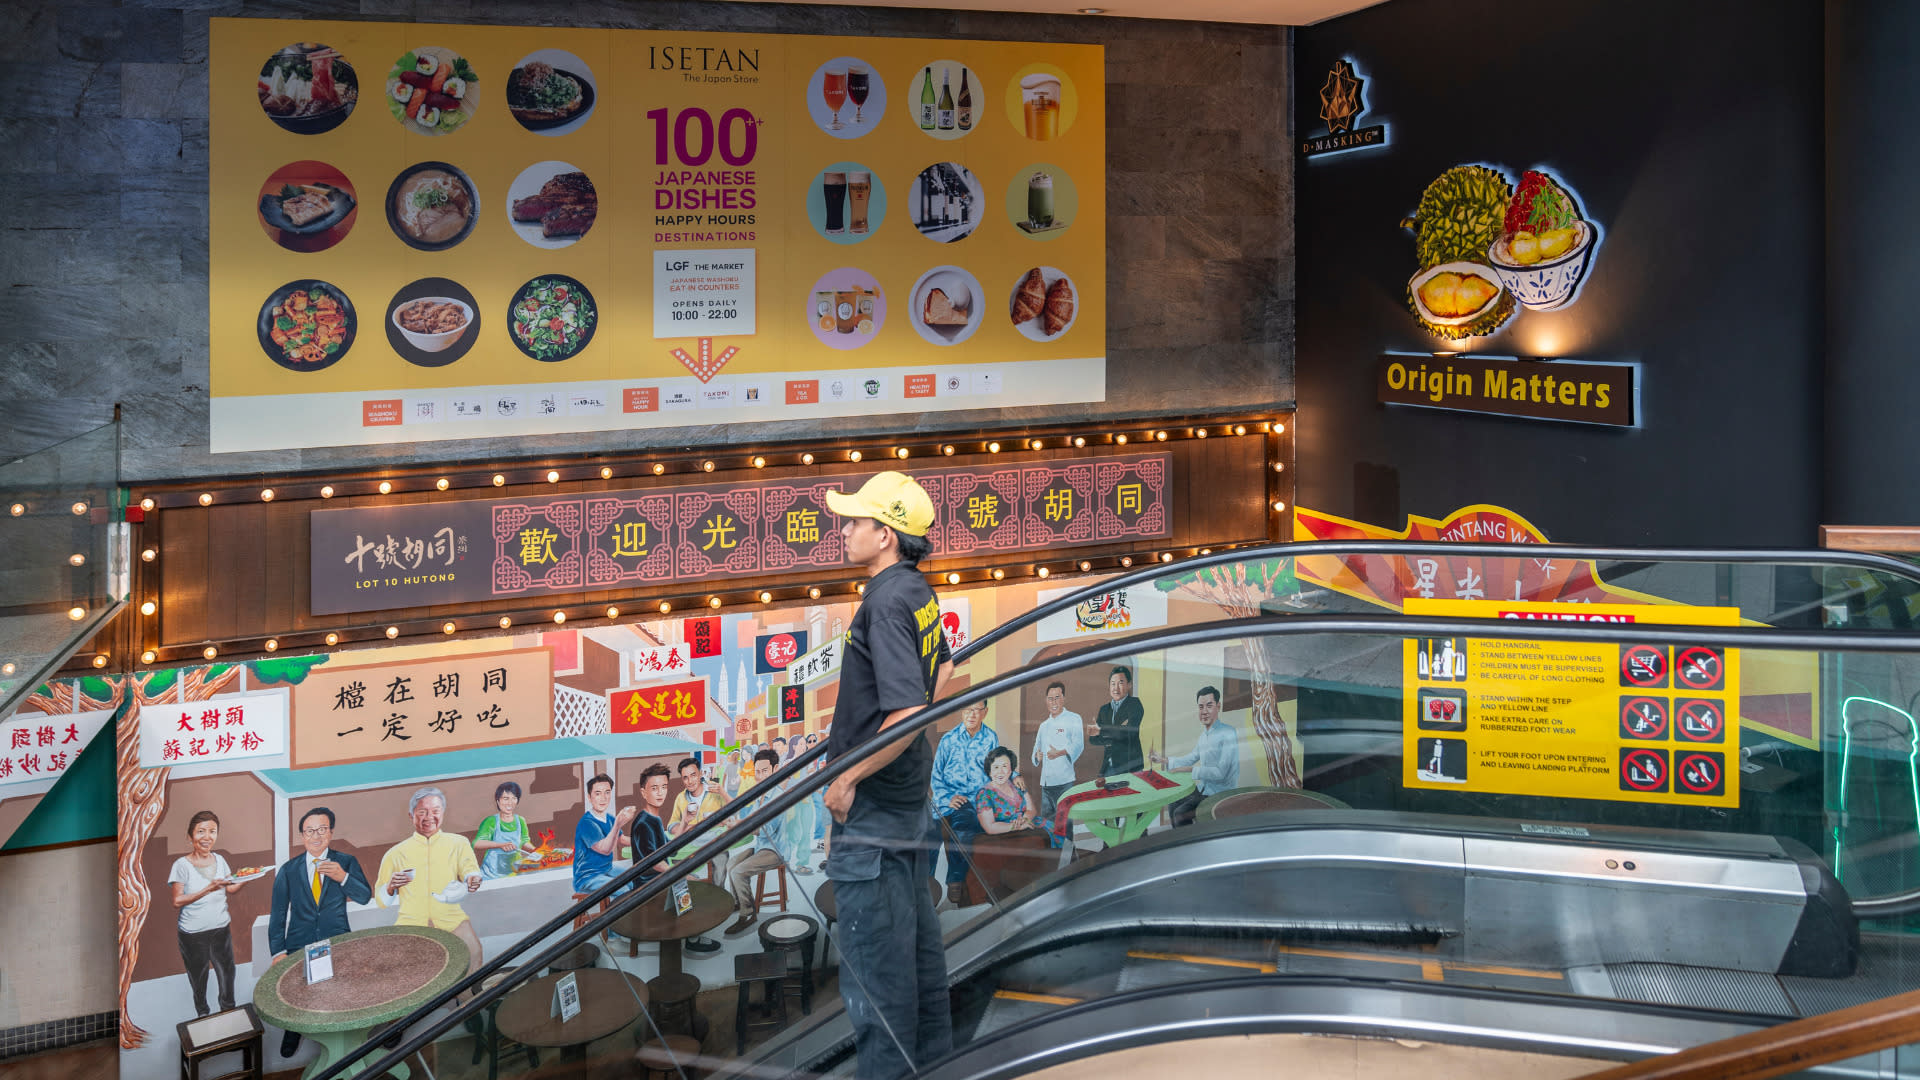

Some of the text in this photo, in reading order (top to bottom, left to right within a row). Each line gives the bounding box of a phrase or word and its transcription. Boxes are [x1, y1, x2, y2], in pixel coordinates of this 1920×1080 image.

[648, 46, 760, 71] ISETAN
[684, 73, 758, 84] The Japan Store
[655, 171, 756, 185] JAPANESE
[655, 188, 756, 210] DISHES
[655, 214, 755, 226] HAPPY HOURS
[655, 231, 756, 243] DESTINATIONS
[665, 261, 689, 271] LGF
[673, 300, 704, 308] OPENS
[672, 311, 698, 321] 10:00
[708, 309, 737, 320] 22:00
[1387, 362, 1611, 408] Origin Matters
[356, 573, 455, 589] LOT 10 HUTONG
[1503, 642, 1541, 650] HANDRAIL
[1480, 662, 1518, 670] CHILDREN
[1555, 665, 1604, 673] SUPERVISED
[1541, 674, 1563, 682] LONG
[332, 667, 508, 711] 檔在胡同
[1507, 695, 1533, 703] WITHIN
[177, 705, 245, 732] 大樹頭
[337, 704, 510, 742] 一定好吃
[1480, 724, 1529, 732] RUBBERIZED
[162, 731, 265, 761] 蘇記炒粉
[1521, 752, 1541, 760] FOOT
[1567, 755, 1606, 763] ENTERING
[1498, 762, 1530, 770] LEAVING
[1532, 763, 1566, 772] LANDING
[1568, 765, 1610, 774] PLATFORM
